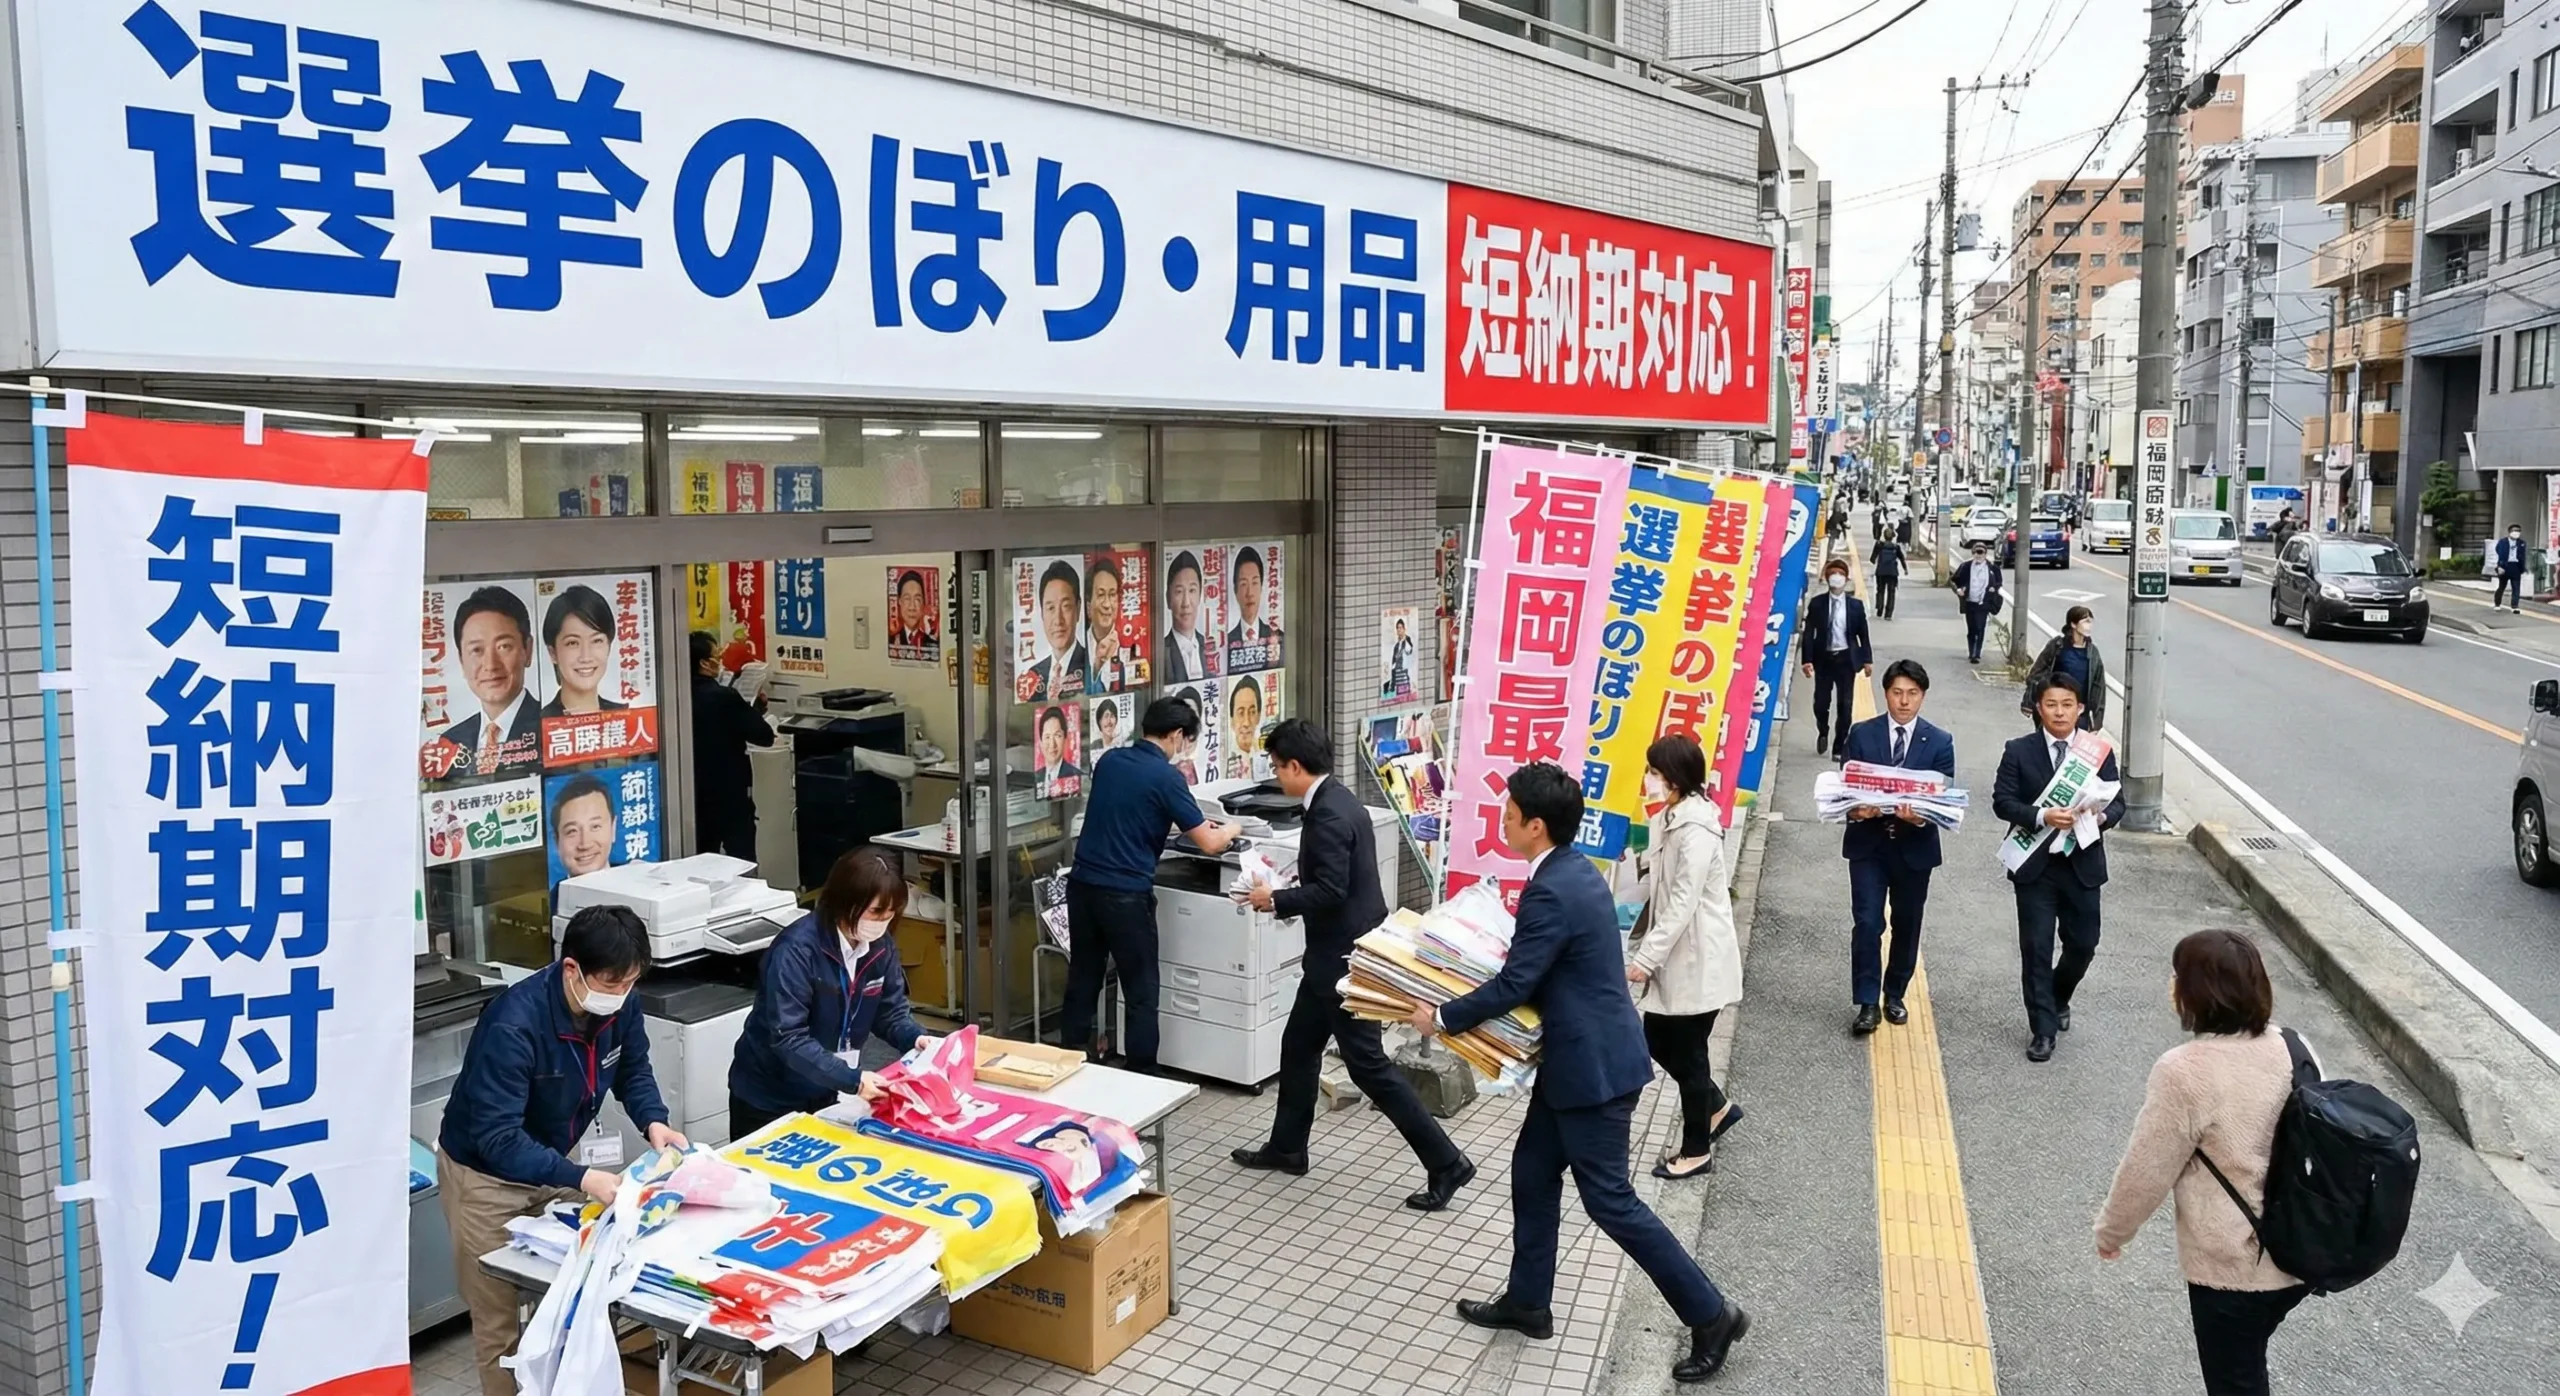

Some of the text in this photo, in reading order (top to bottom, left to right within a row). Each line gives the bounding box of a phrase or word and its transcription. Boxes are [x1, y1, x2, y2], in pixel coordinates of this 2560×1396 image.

[124, 0, 1427, 374] 選挙のぼり・用品
[1460, 214, 1757, 395] 短納期対応！
[1641, 498, 1748, 818] 選挙のぼ
[145, 494, 341, 1391] 短納期対応！
